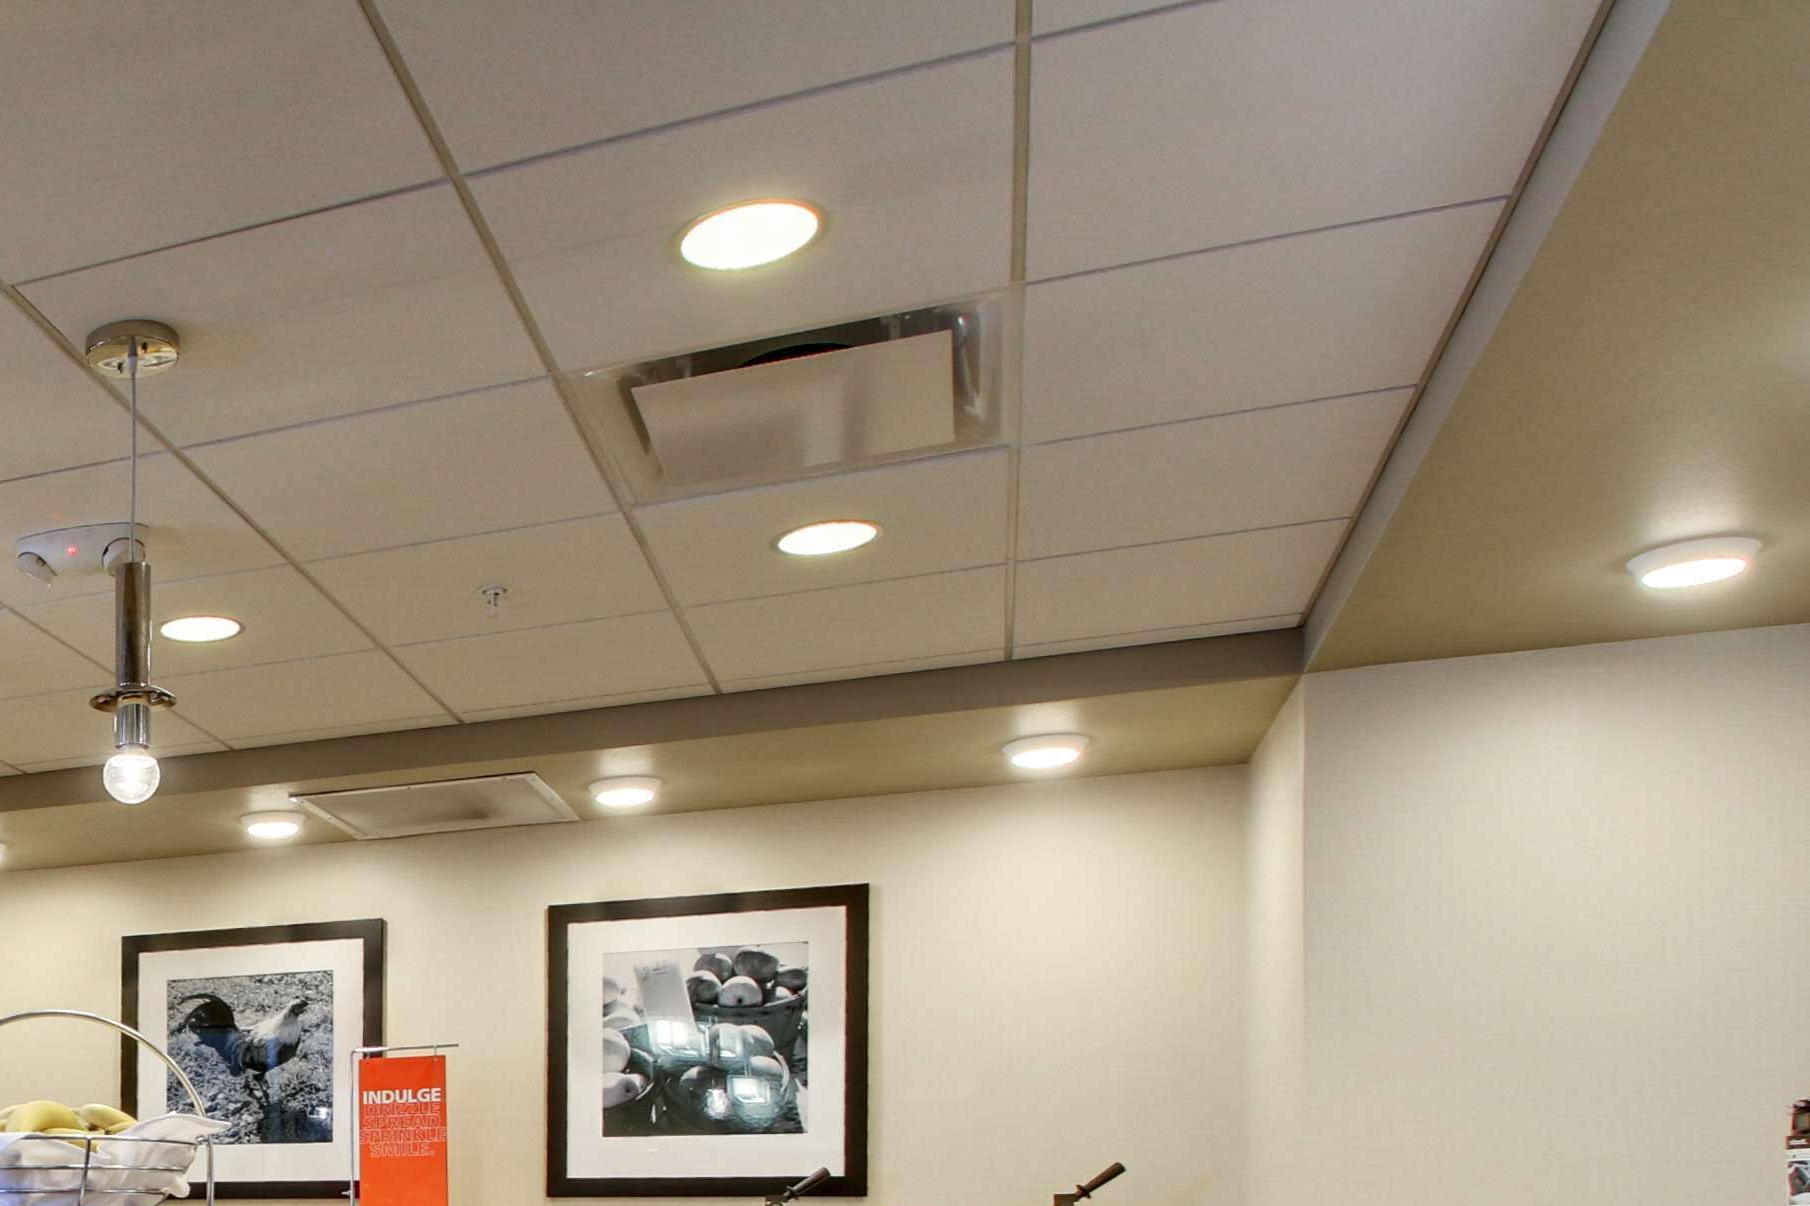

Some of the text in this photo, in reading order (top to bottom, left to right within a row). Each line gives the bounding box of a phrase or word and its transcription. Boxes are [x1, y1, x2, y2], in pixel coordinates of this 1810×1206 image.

[363, 1088, 442, 1105] INDULGE
[365, 1102, 440, 1118] DRIZZLE
[365, 1113, 442, 1131] SPREAD
[359, 1126, 446, 1144] SPRINKLE
[370, 1140, 435, 1158] SMILE.
